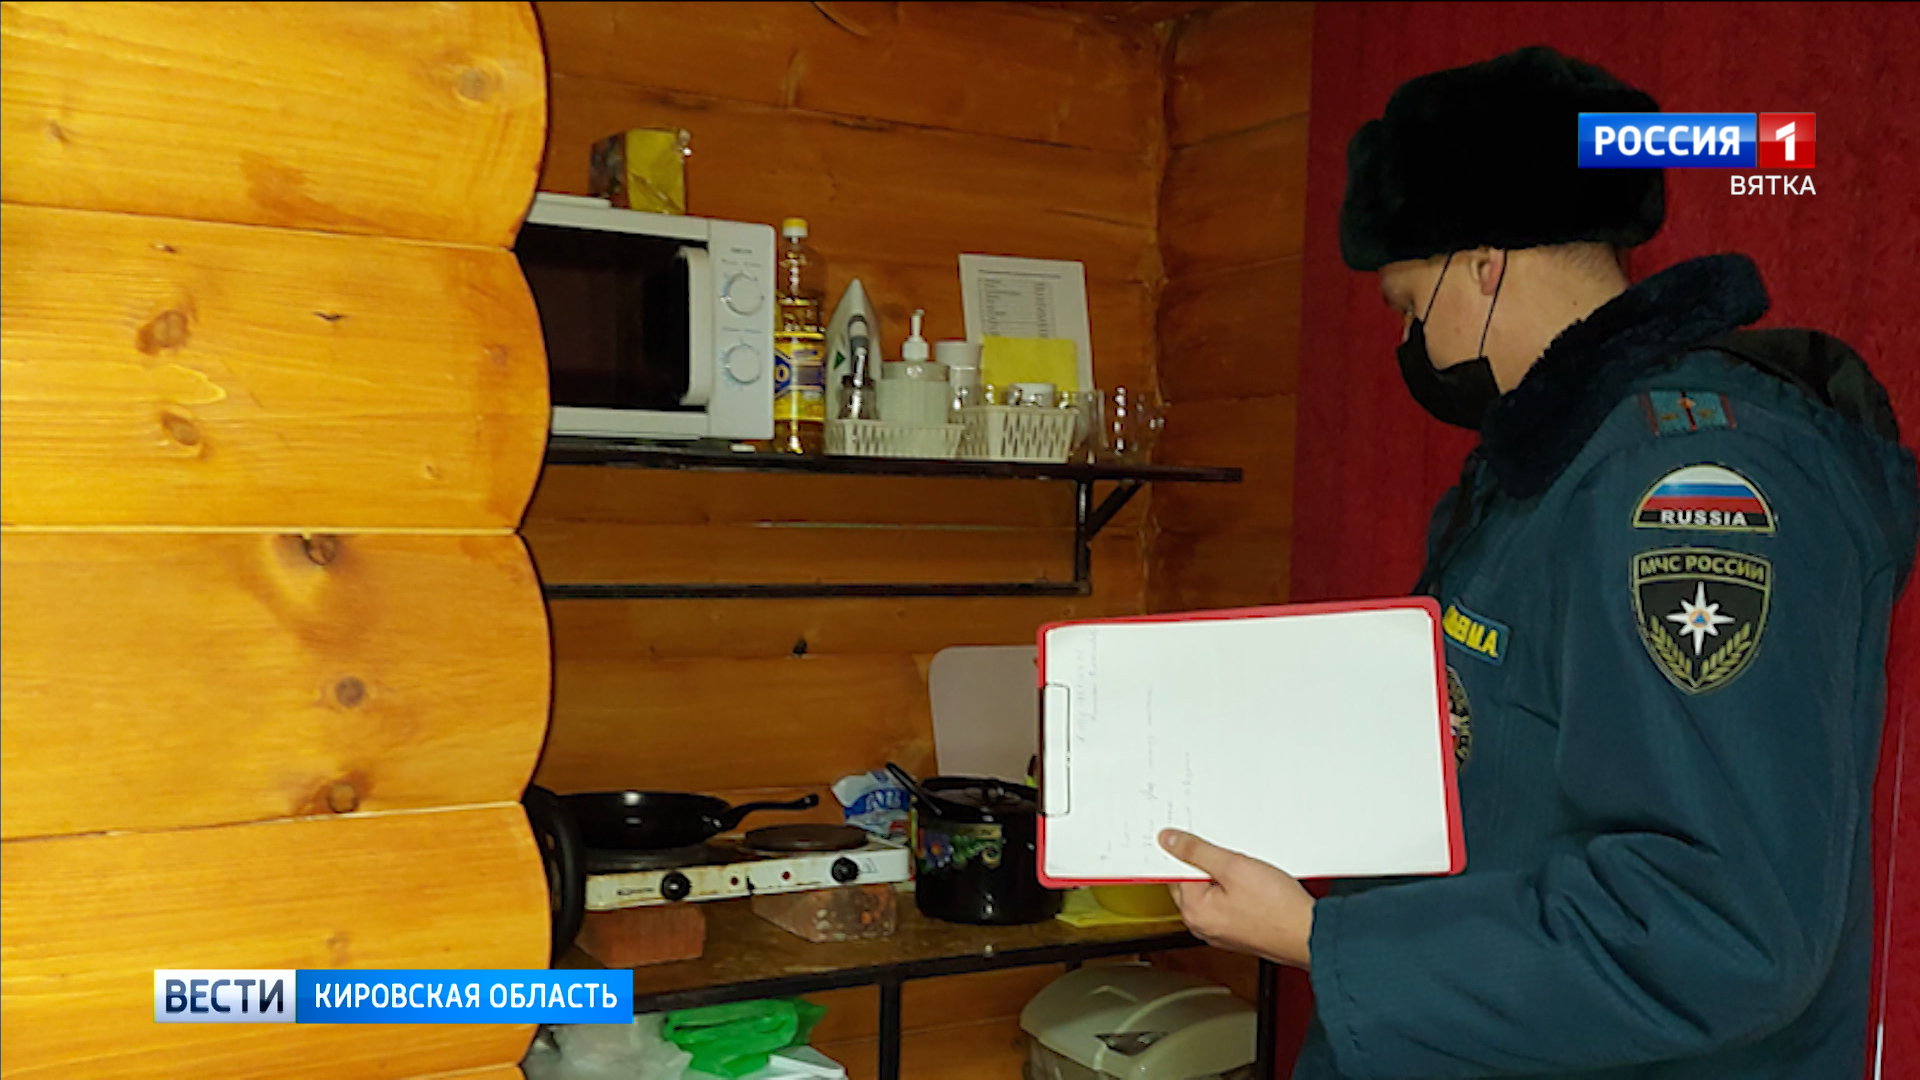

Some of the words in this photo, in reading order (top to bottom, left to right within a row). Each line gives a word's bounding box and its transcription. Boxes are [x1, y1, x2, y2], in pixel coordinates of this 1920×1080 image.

[1660, 508, 1748, 527] RUSSIA
[1640, 555, 1683, 577] МЧС
[1685, 555, 1766, 582] РОССИИ
